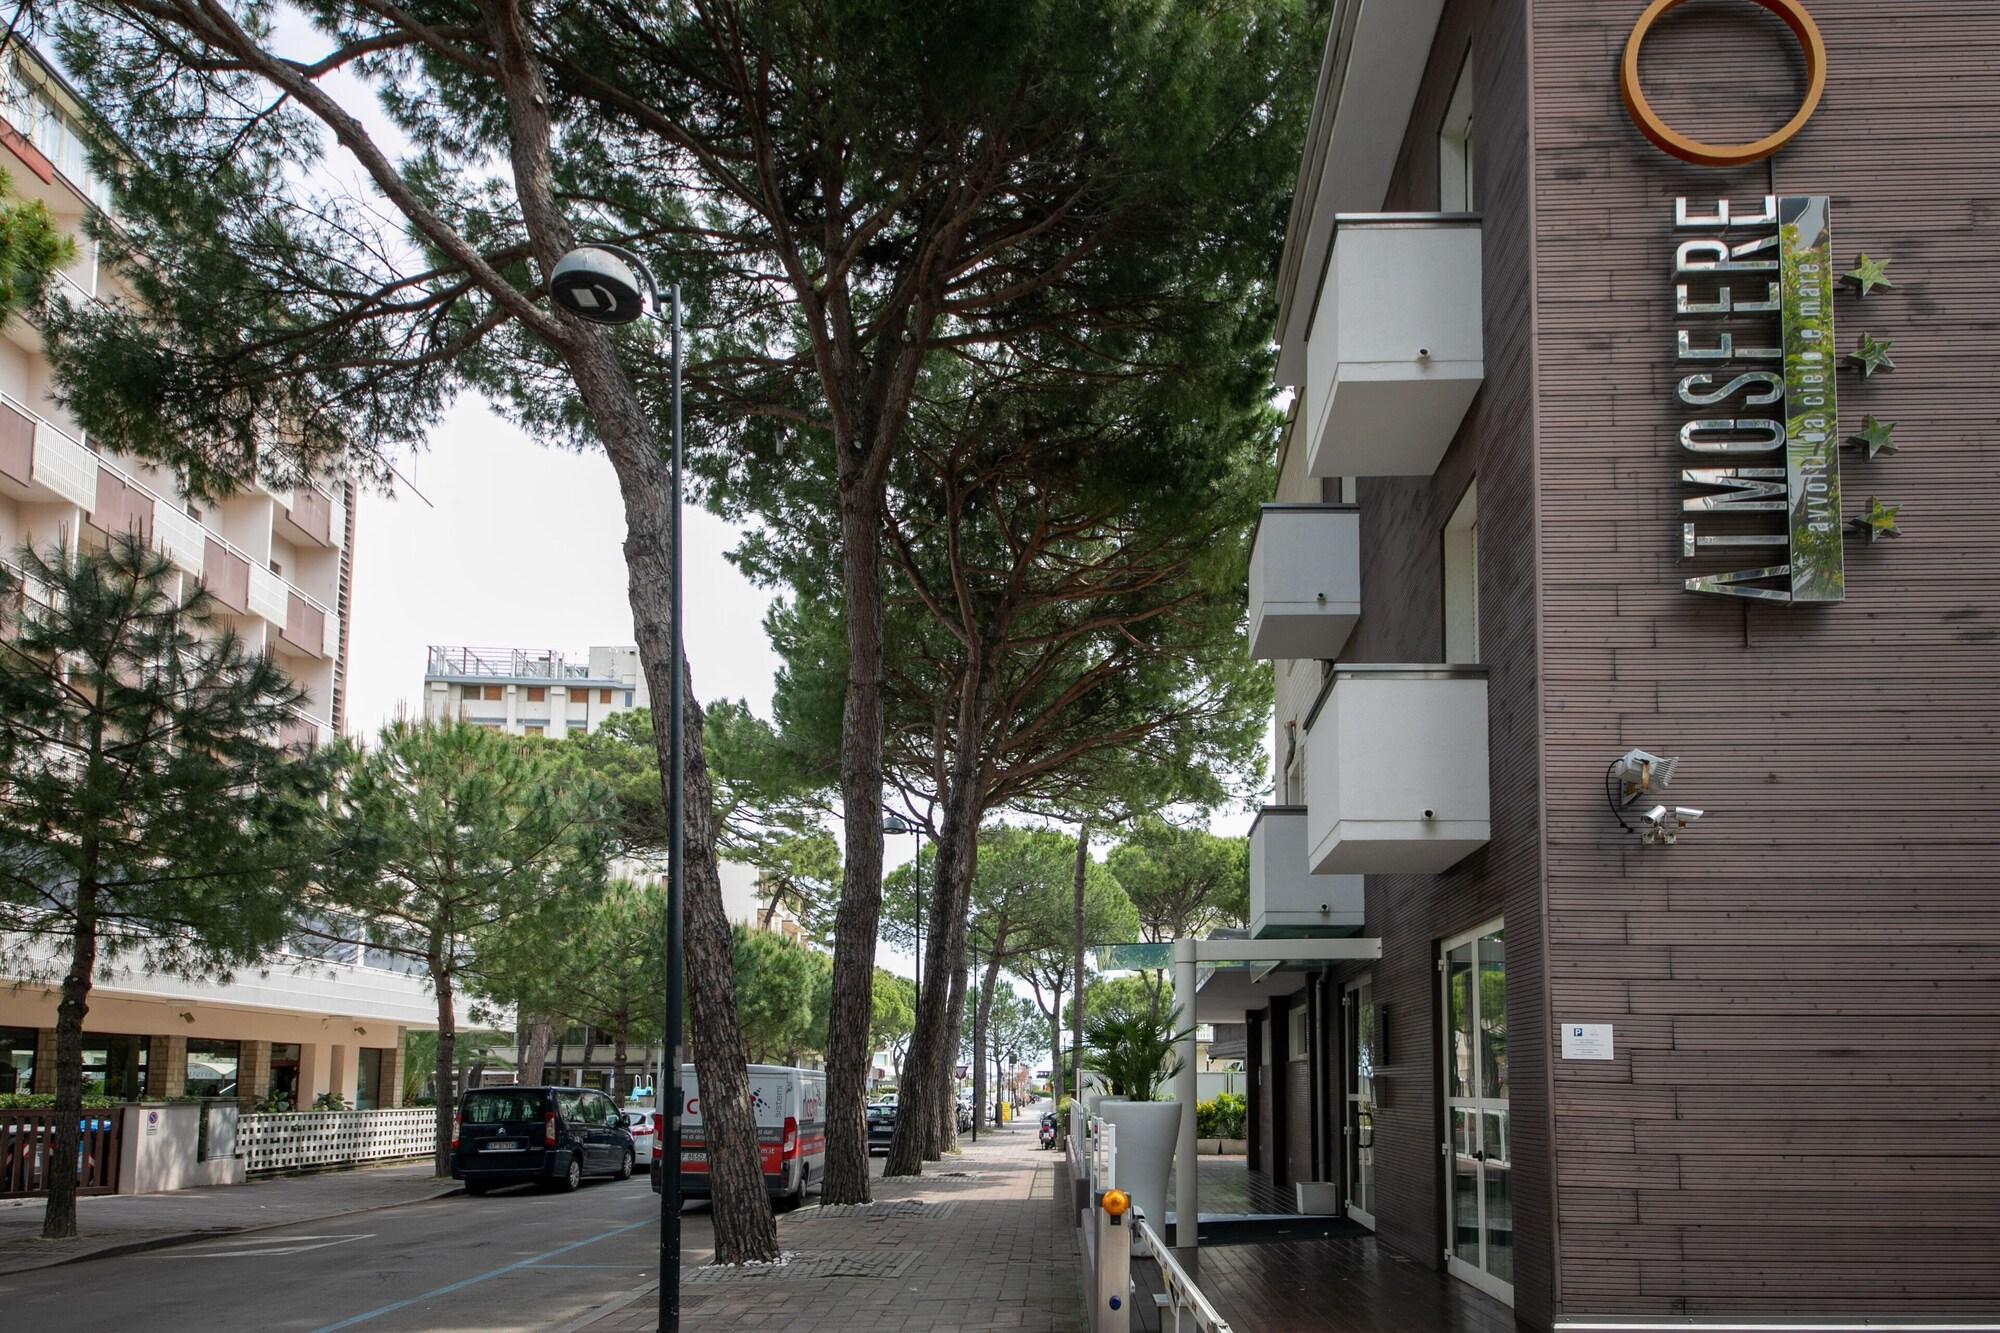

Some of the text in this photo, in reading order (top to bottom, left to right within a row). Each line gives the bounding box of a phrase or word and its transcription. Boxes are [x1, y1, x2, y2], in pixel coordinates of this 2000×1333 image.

[1676, 194, 1792, 600] ATMOSFERE
[1796, 262, 1832, 533] avvolti da cielo e mare
